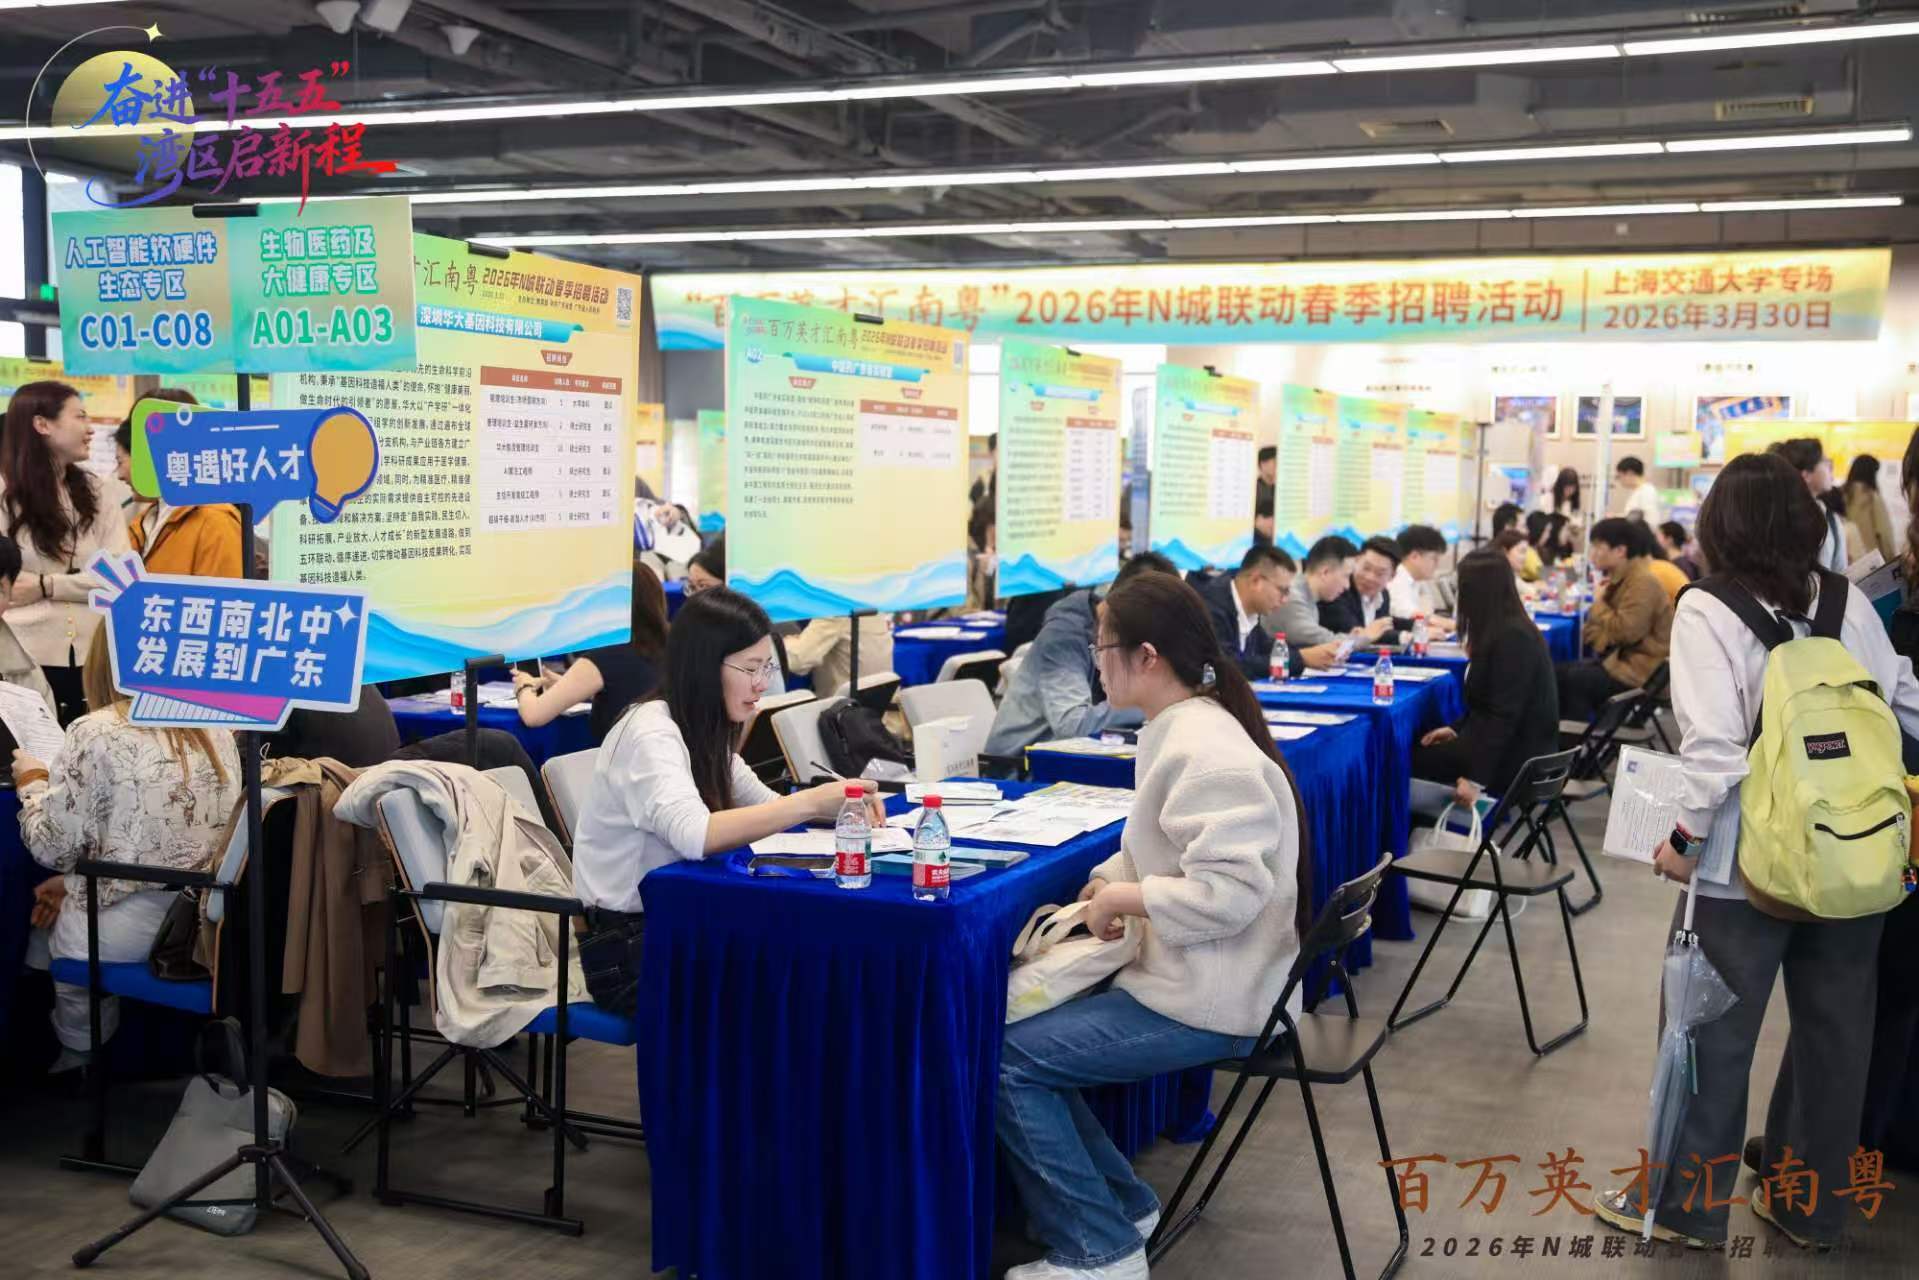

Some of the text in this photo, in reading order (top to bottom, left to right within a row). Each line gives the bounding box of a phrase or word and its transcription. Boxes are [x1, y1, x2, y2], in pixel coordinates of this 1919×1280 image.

[65, 231, 217, 268] 人工智能软硬件
[260, 225, 377, 260] 生物医药及
[99, 269, 186, 301] 生态专区
[262, 262, 378, 296] 大健康专区
[1604, 265, 1833, 298] 上海交通大学专场
[1016, 278, 1564, 326] 2026年N城联动春季招聘活动
[1604, 300, 1832, 330] 2026年3月30日
[80, 312, 213, 348] C01-C08
[253, 307, 393, 345] A01-A03
[420, 306, 543, 338] 深圳华大基因科技有限公司
[166, 443, 305, 487] 粤遇好人才
[140, 594, 333, 644] 东西南北中
[132, 636, 327, 688] 发展到广东
